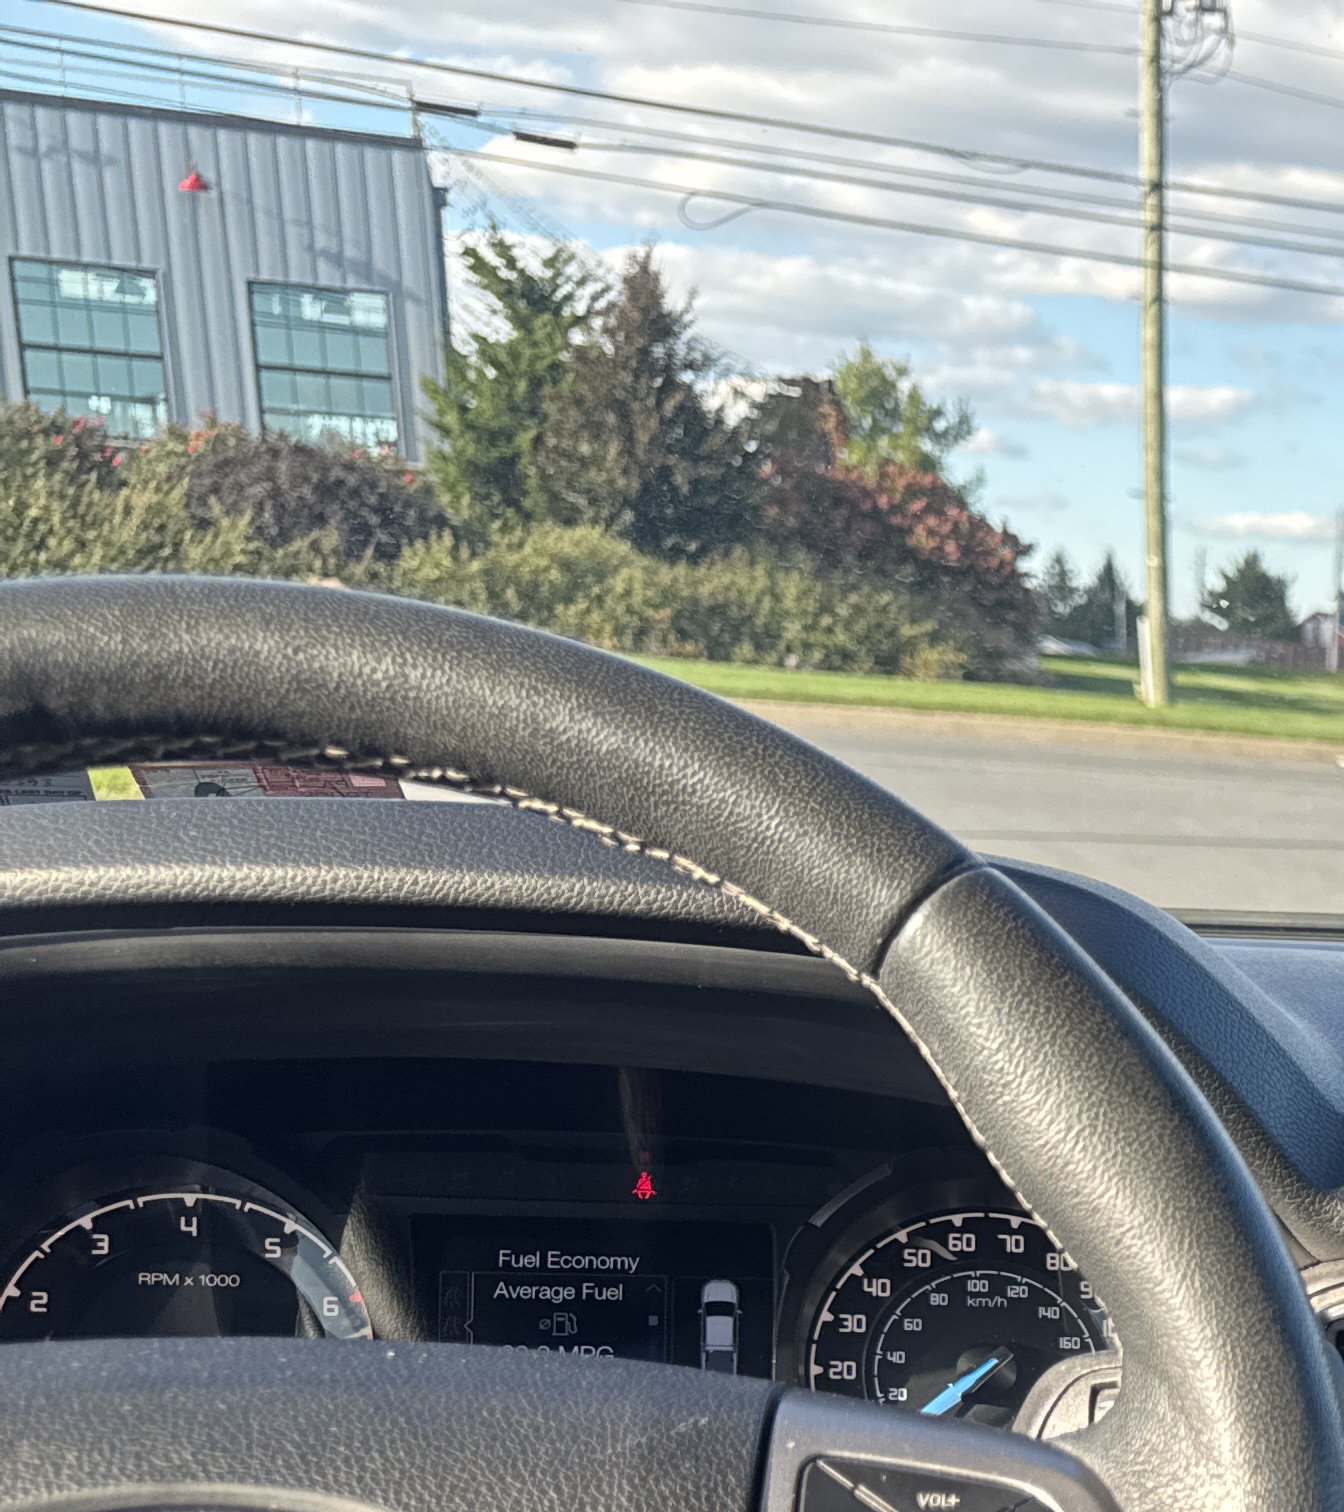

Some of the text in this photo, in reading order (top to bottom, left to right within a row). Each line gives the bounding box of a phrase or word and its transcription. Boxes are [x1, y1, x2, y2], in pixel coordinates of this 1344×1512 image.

[180, 1216, 198, 1237] 4
[91, 1234, 110, 1255] 3
[264, 1237, 282, 1258] 5
[947, 1233, 976, 1252] 60
[997, 1234, 1025, 1254] 70
[498, 1249, 640, 1273] Fuel Economy
[903, 1248, 931, 1268] 50
[137, 1272, 241, 1288] RPM x 1000
[862, 1278, 891, 1297] 40
[966, 1279, 989, 1293] 100
[493, 1281, 623, 1304] Average Fuel
[929, 1293, 949, 1307] 80
[1006, 1284, 1029, 1298] 120
[29, 1292, 49, 1312] 2
[322, 1296, 339, 1317] 6
[966, 1295, 1008, 1309] km/h
[1038, 1306, 1060, 1319] 140
[838, 1314, 867, 1333] 30
[903, 1318, 922, 1332] 60
[1059, 1336, 1081, 1350] 160
[886, 1350, 905, 1364] 40
[828, 1360, 857, 1381] 20
[888, 1386, 908, 1401] 20
